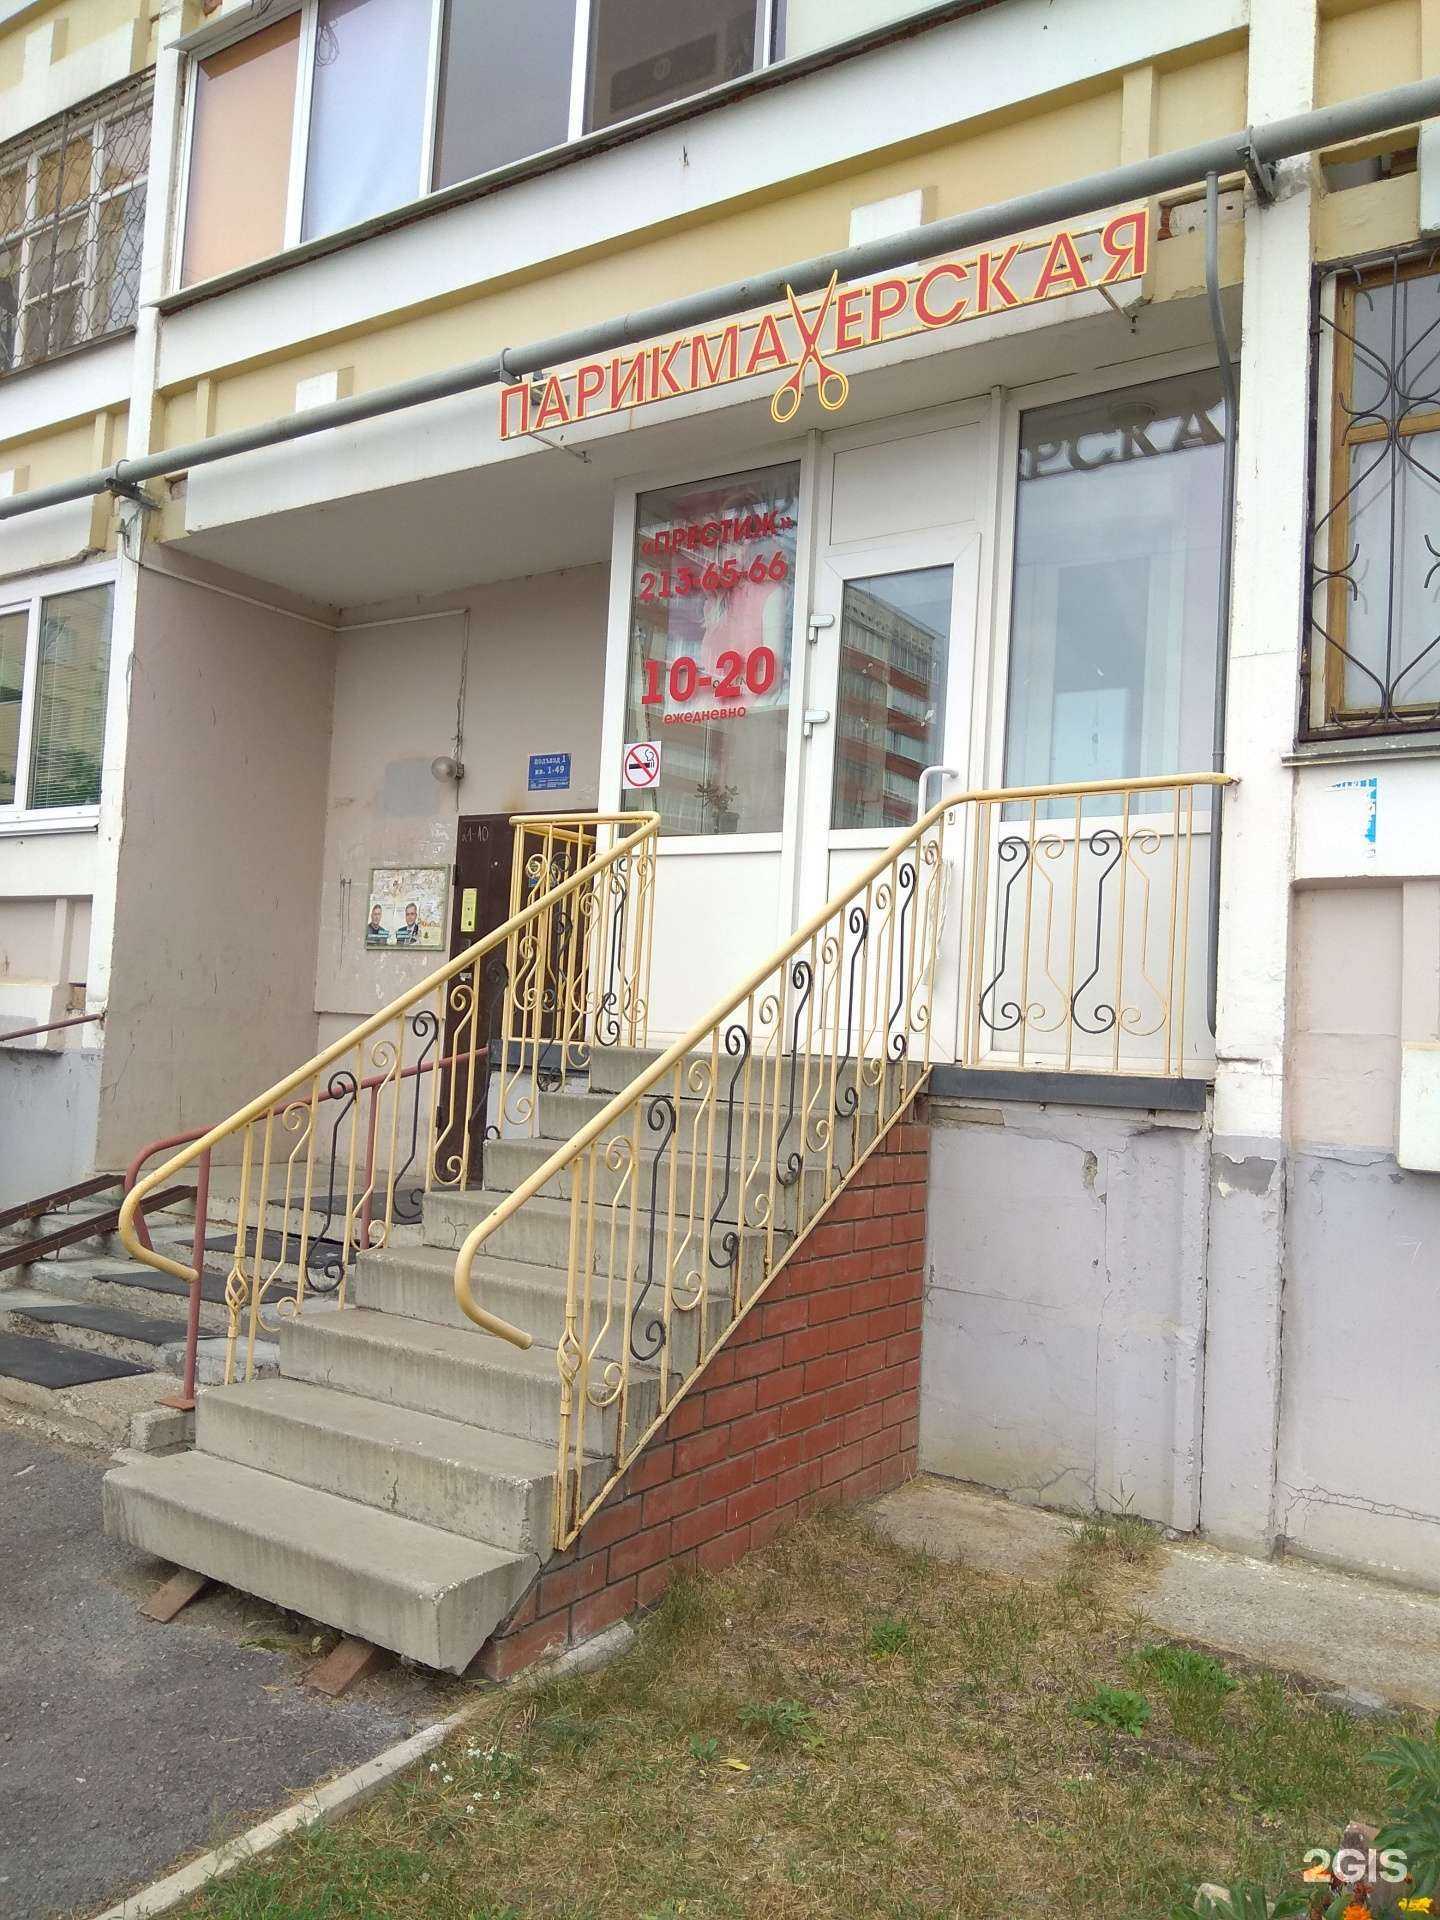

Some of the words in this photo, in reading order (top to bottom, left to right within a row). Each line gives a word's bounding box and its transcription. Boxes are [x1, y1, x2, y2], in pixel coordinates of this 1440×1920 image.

[500, 207, 1150, 441] ПАРИКМАХЕРСКАЯ
[639, 550, 788, 601] 213-65-66
[641, 646, 775, 705] 10-20
[664, 706, 746, 725] ежедневно
